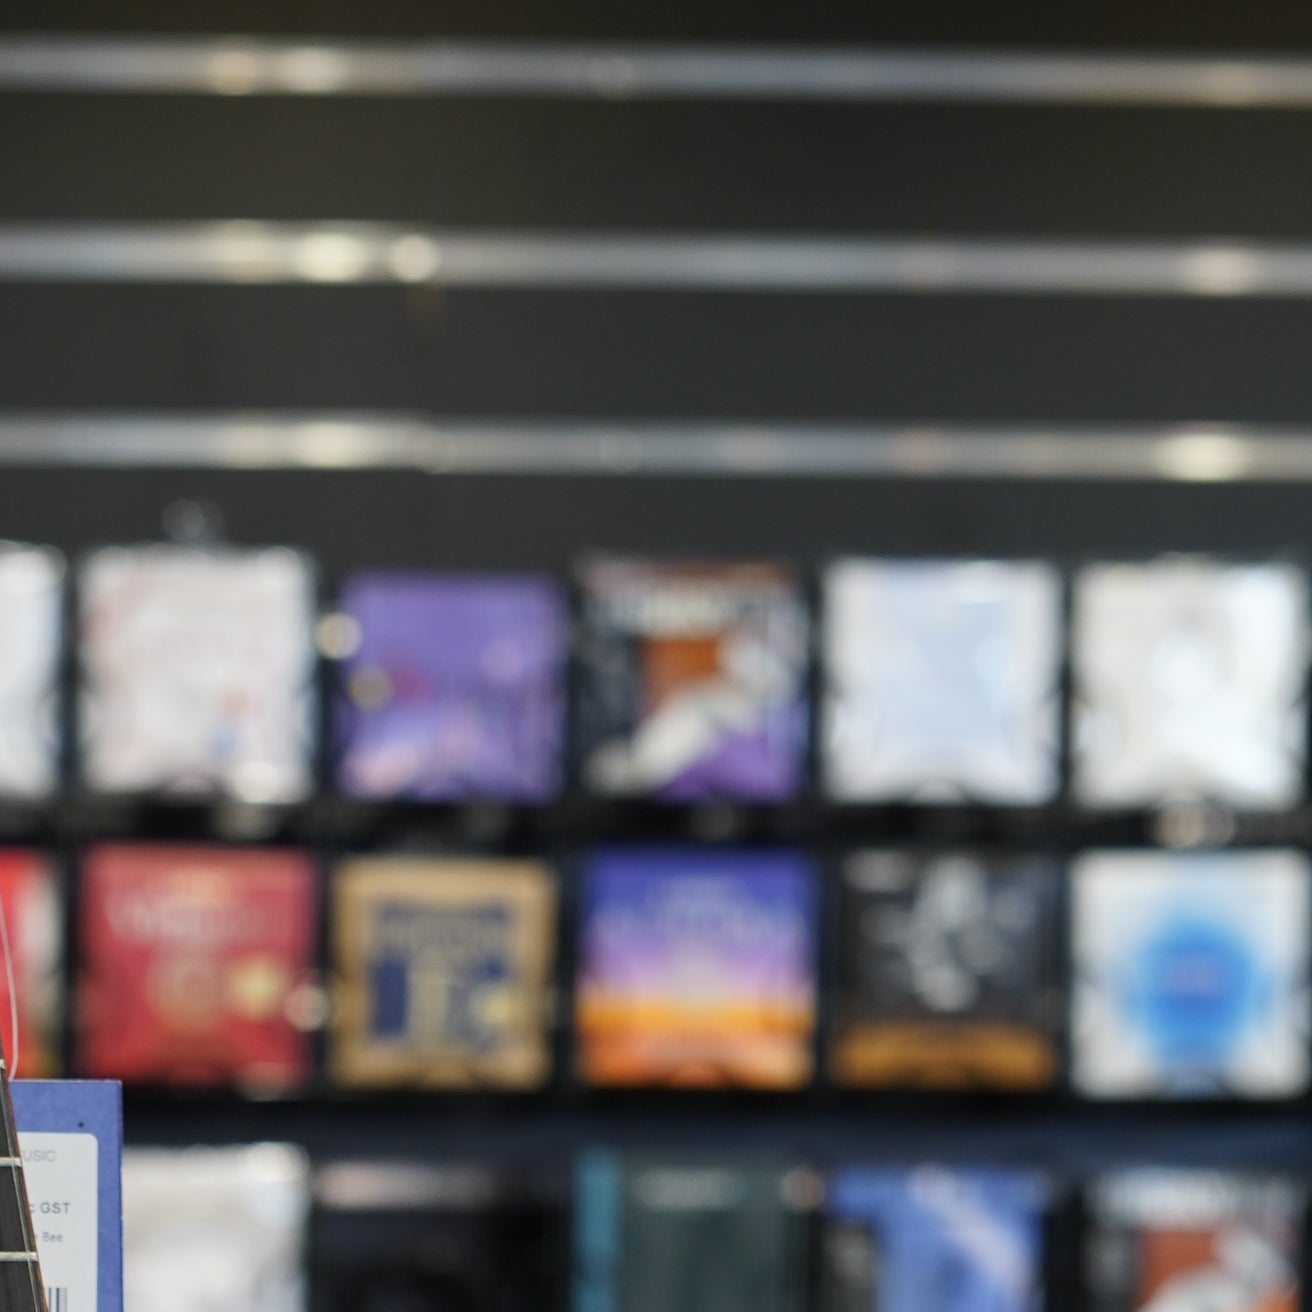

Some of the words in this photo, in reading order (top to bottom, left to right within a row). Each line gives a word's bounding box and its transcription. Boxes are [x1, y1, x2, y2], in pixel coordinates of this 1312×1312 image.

[23, 1149, 56, 1162] USIC
[40, 1202, 71, 1214] GST
[42, 1231, 63, 1243] Bee
